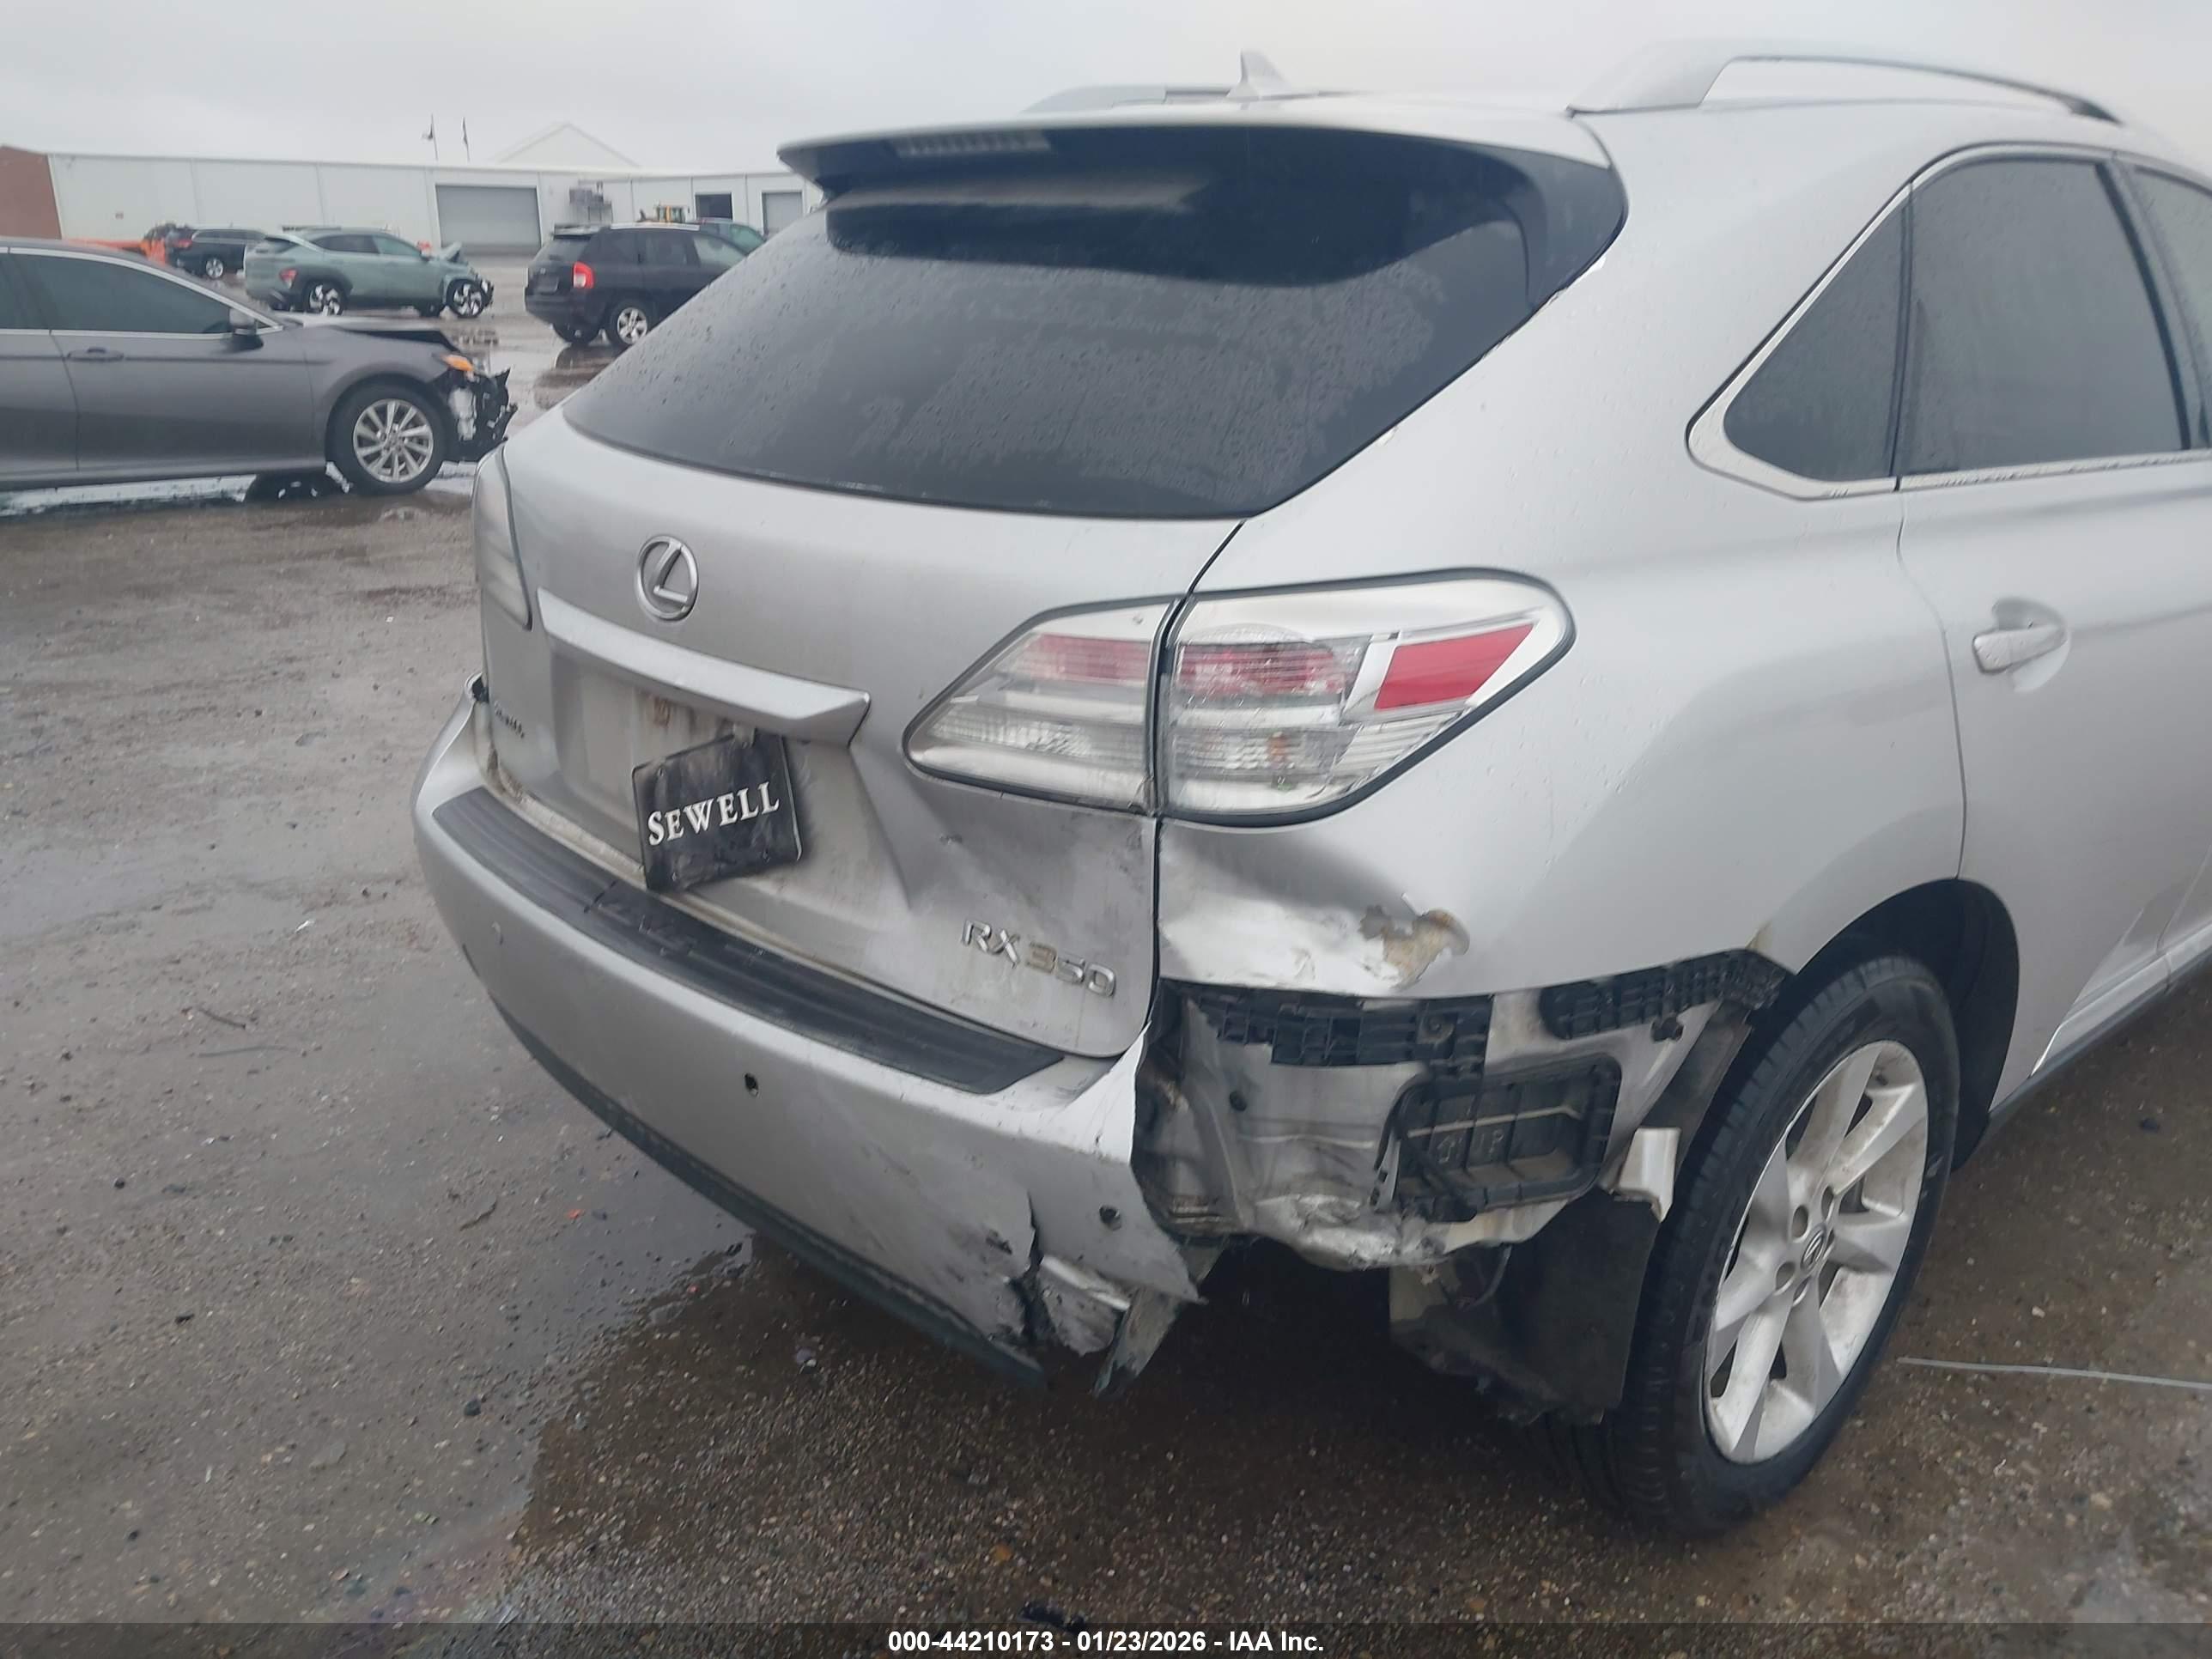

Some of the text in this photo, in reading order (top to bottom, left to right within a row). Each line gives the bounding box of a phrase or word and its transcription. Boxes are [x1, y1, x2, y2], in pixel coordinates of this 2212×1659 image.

[647, 781, 780, 847] SEWELL
[961, 919, 1117, 998] RX 350
